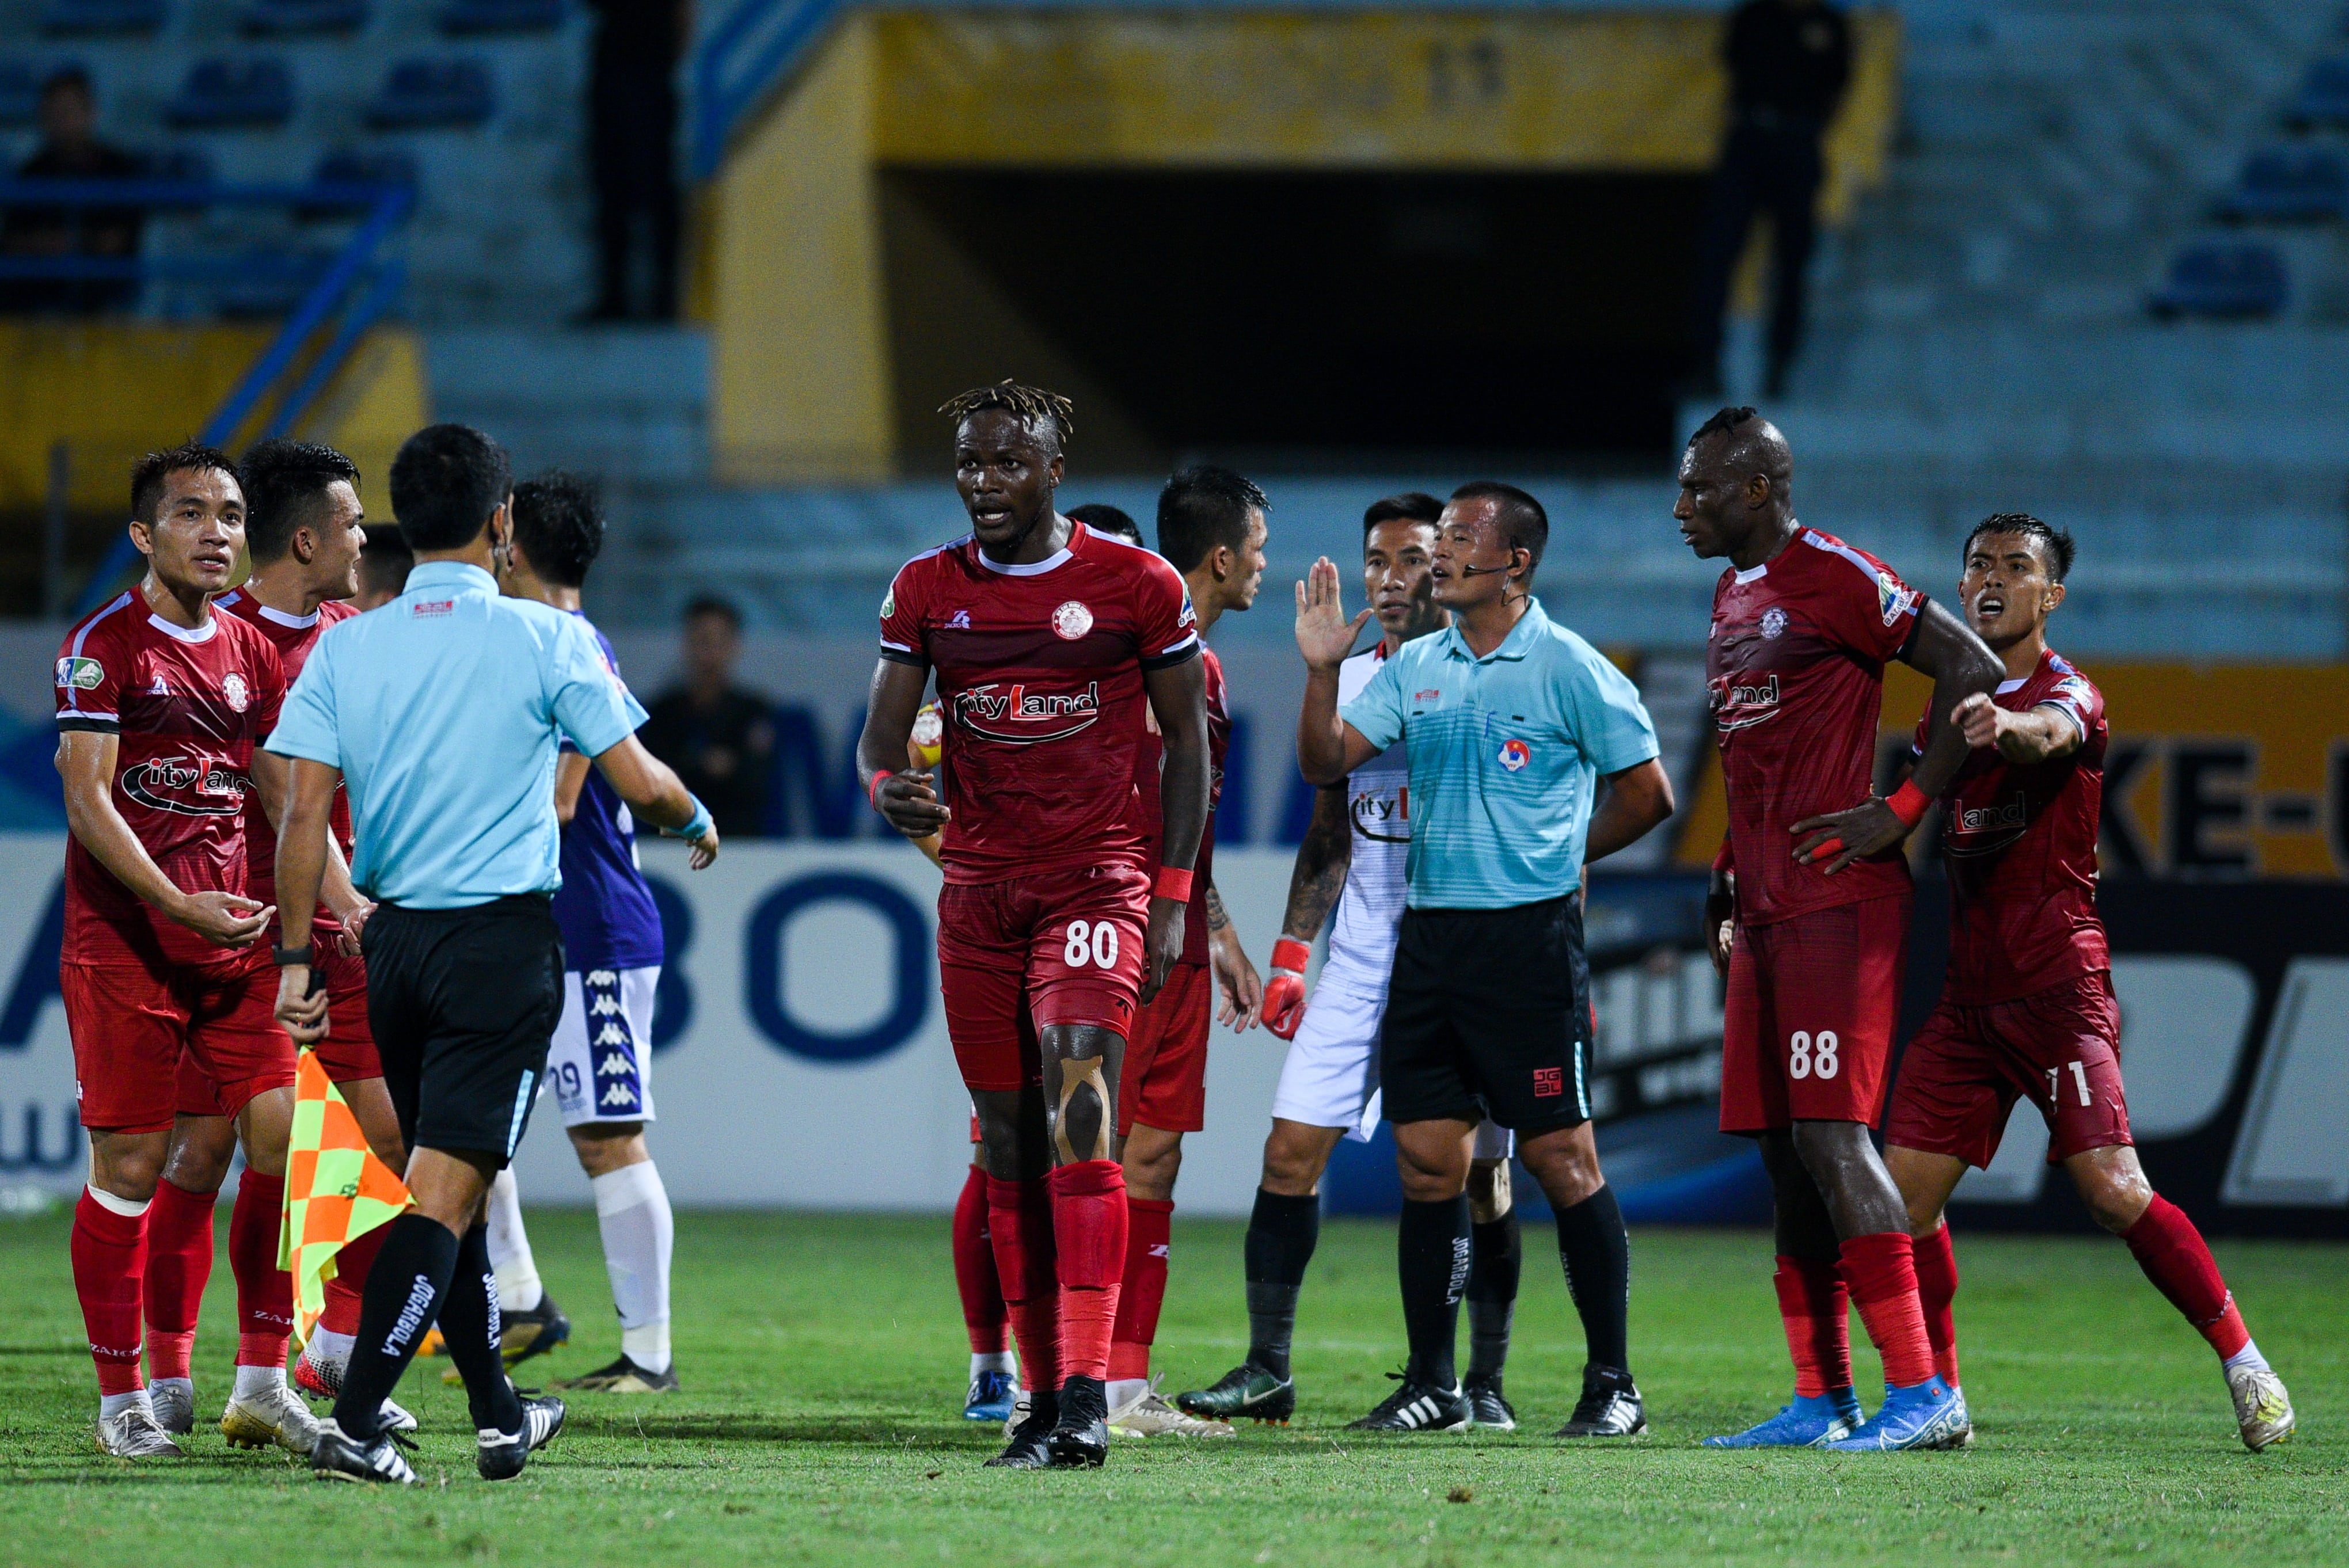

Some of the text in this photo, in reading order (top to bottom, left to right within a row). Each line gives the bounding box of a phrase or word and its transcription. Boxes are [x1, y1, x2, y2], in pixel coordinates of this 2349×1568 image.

[953, 681, 1099, 745] CityLand
[1064, 919, 1119, 970] 80
[1789, 1030, 1838, 1079] 88
[1445, 1237, 1469, 1305] JOGARBOLA
[381, 1273, 436, 1357] JOGARBOLA
[482, 1272, 501, 1350] JOGARBOLA
